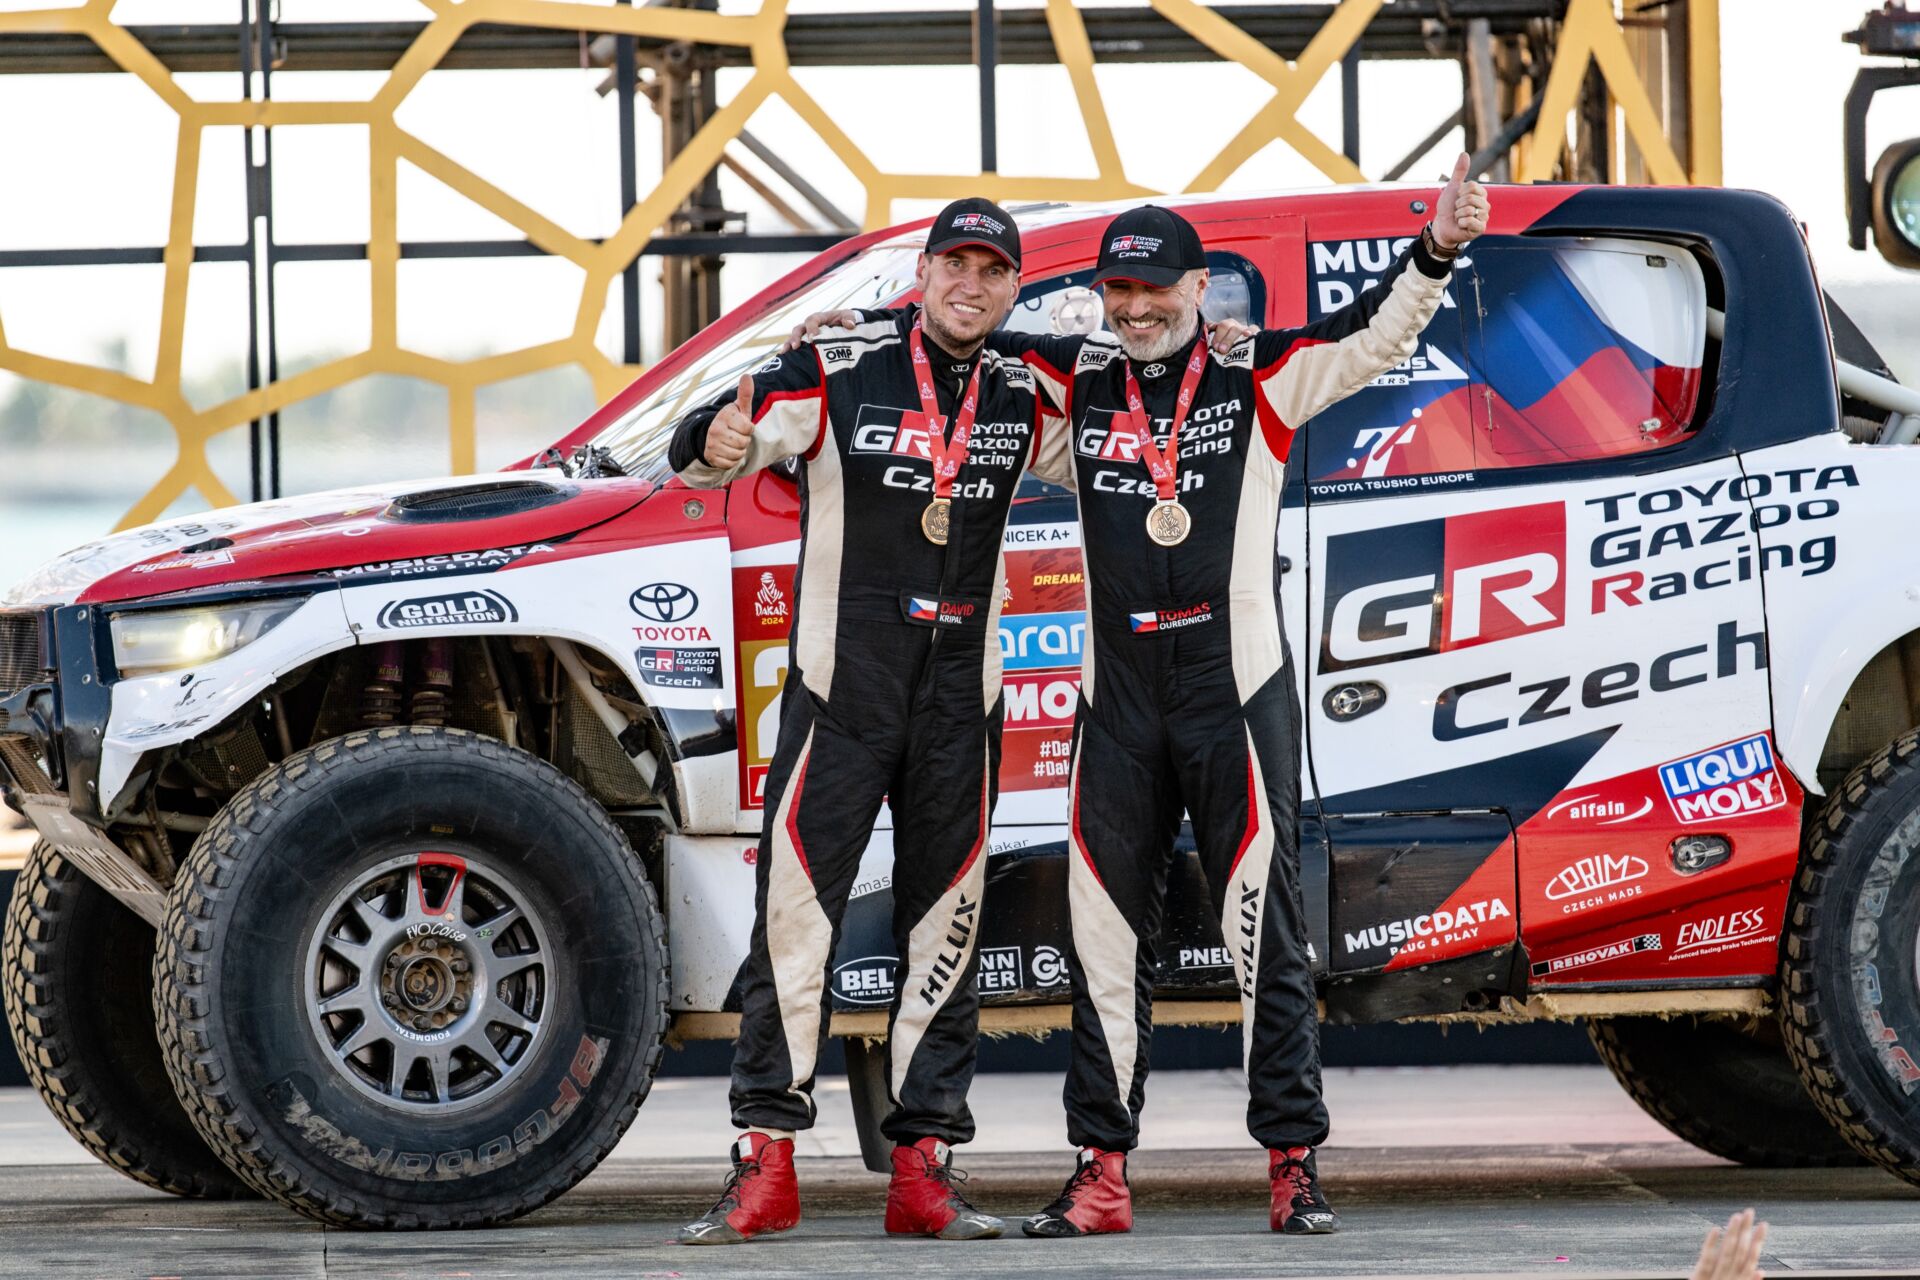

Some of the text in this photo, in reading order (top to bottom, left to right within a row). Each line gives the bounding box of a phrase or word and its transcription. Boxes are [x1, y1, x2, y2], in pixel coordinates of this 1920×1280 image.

[963, 226, 993, 235] Czech
[1135, 235, 1163, 243] TOYOTA
[1118, 251, 1150, 259] Czech
[825, 346, 852, 361] OMP
[1080, 351, 1108, 364] OMP
[1225, 348, 1249, 361] OMP
[969, 422, 1029, 435] OYOTA
[854, 424, 932, 459] GR
[966, 438, 1020, 451] AZOO
[1079, 428, 1140, 460] GR
[1311, 472, 1474, 496] TOYOTA TSUSHO EUROPE
[1585, 464, 1861, 523] TOYOTA
[1050, 529, 1071, 541] A+
[1590, 498, 1840, 569] GAZOO
[333, 543, 556, 578] MUSICDATA
[390, 557, 512, 576] PLUG & PLAY
[1591, 535, 1837, 616] Racing
[400, 596, 489, 620] GOLD
[755, 601, 788, 617] DAKAR
[940, 602, 976, 617] DAVID
[1158, 602, 1212, 621] TOMAS
[1328, 551, 1560, 663] GR
[397, 610, 501, 627] NUTRITION
[761, 617, 785, 625] 2024
[939, 613, 963, 625] KRIPAL
[1158, 612, 1214, 631] OUREDNICEK
[632, 626, 713, 642] TOYOTA
[675, 657, 716, 666] GAZOO
[676, 649, 720, 659] TOYOTA
[640, 656, 674, 672] GR
[675, 664, 714, 674] Racing
[654, 674, 703, 687] Czech
[1432, 620, 1768, 742] Czech
[1665, 739, 1769, 796] LIQUI
[1676, 771, 1774, 820] MOLY
[1569, 800, 1626, 819] alfain
[1557, 853, 1631, 894] PRIM
[1562, 885, 1643, 914] CZECH MADE
[1344, 898, 1511, 954] MUSICDATA
[1676, 906, 1765, 946] ENDLESS
[920, 892, 977, 1007] HILUX
[1240, 880, 1260, 1000] HILUX
[1389, 926, 1479, 956] PLUG & PLAY
[1668, 934, 1777, 962] Advanced Racing Brake Technology
[1552, 942, 1631, 970] RENOVAK
[841, 966, 897, 992] BEL
[393, 1023, 451, 1043] FONDMETAL
